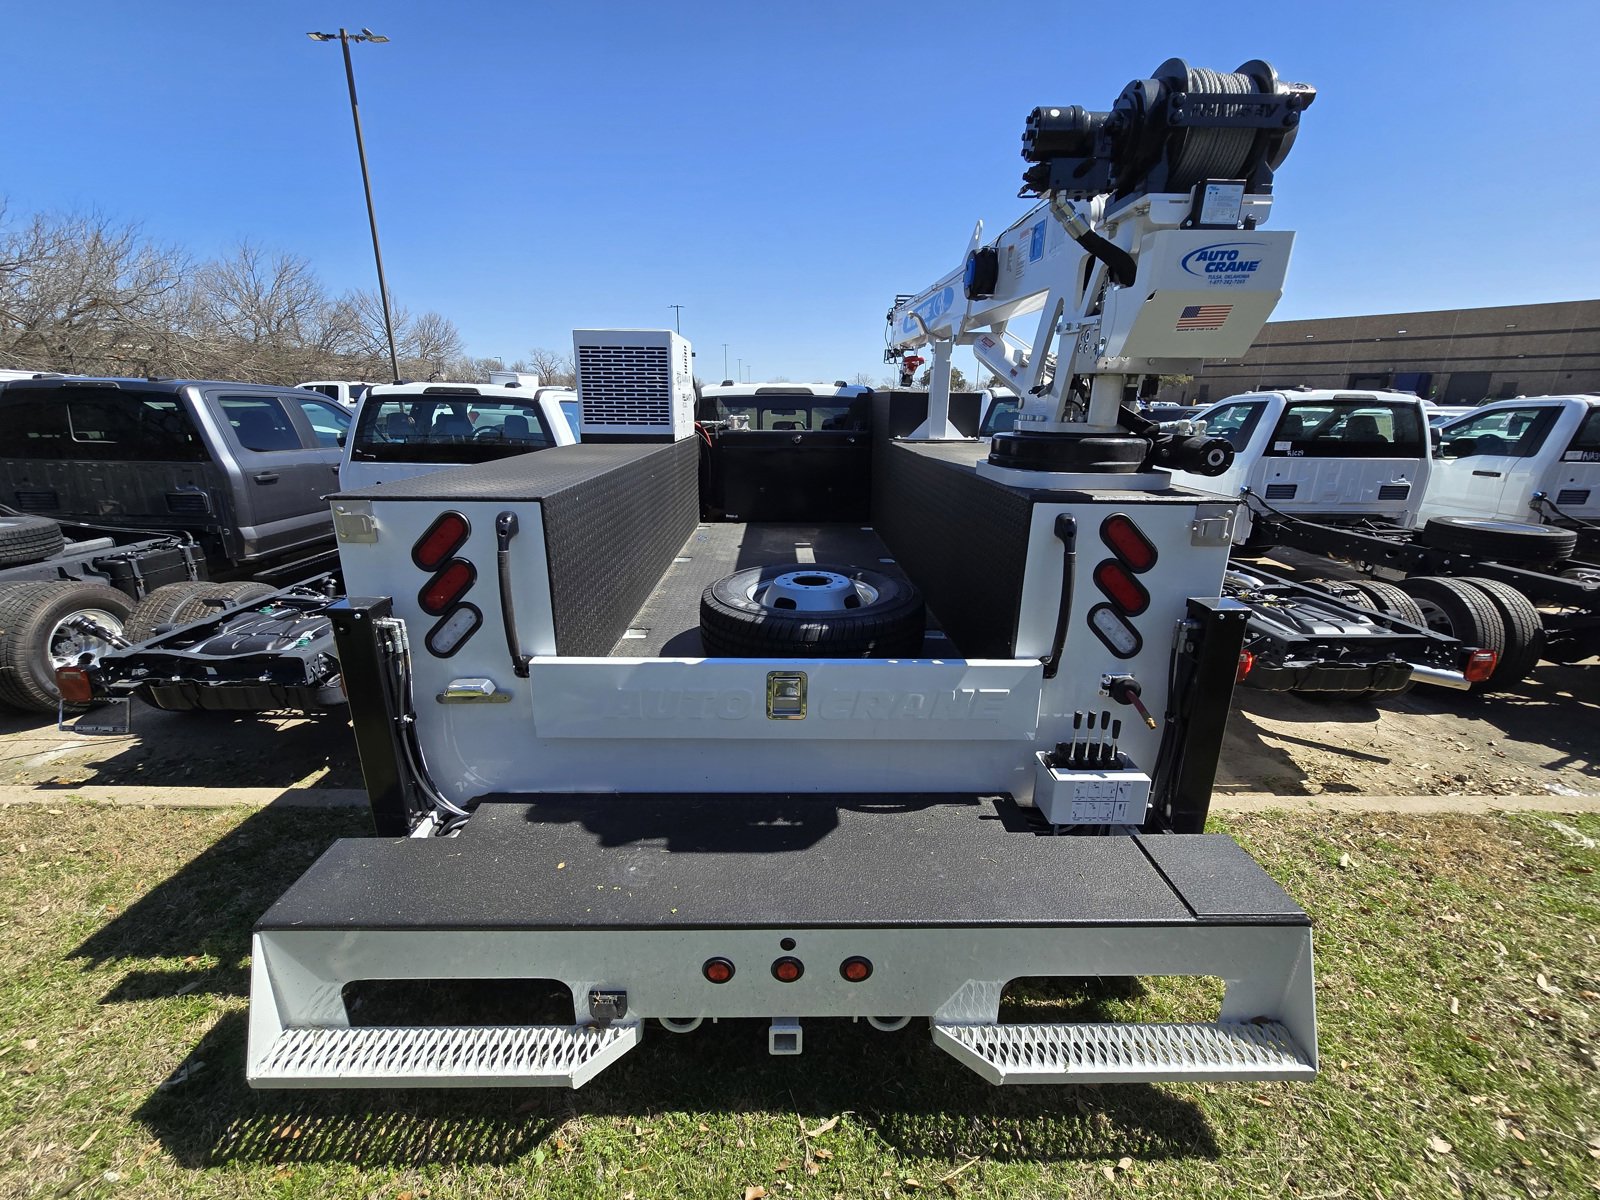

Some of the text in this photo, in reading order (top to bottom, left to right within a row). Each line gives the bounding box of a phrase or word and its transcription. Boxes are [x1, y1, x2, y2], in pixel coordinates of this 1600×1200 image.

[1195, 250, 1239, 261] AUTO
[1205, 260, 1262, 272] CRANE
[602, 688, 1011, 720] AUTO CRANE
